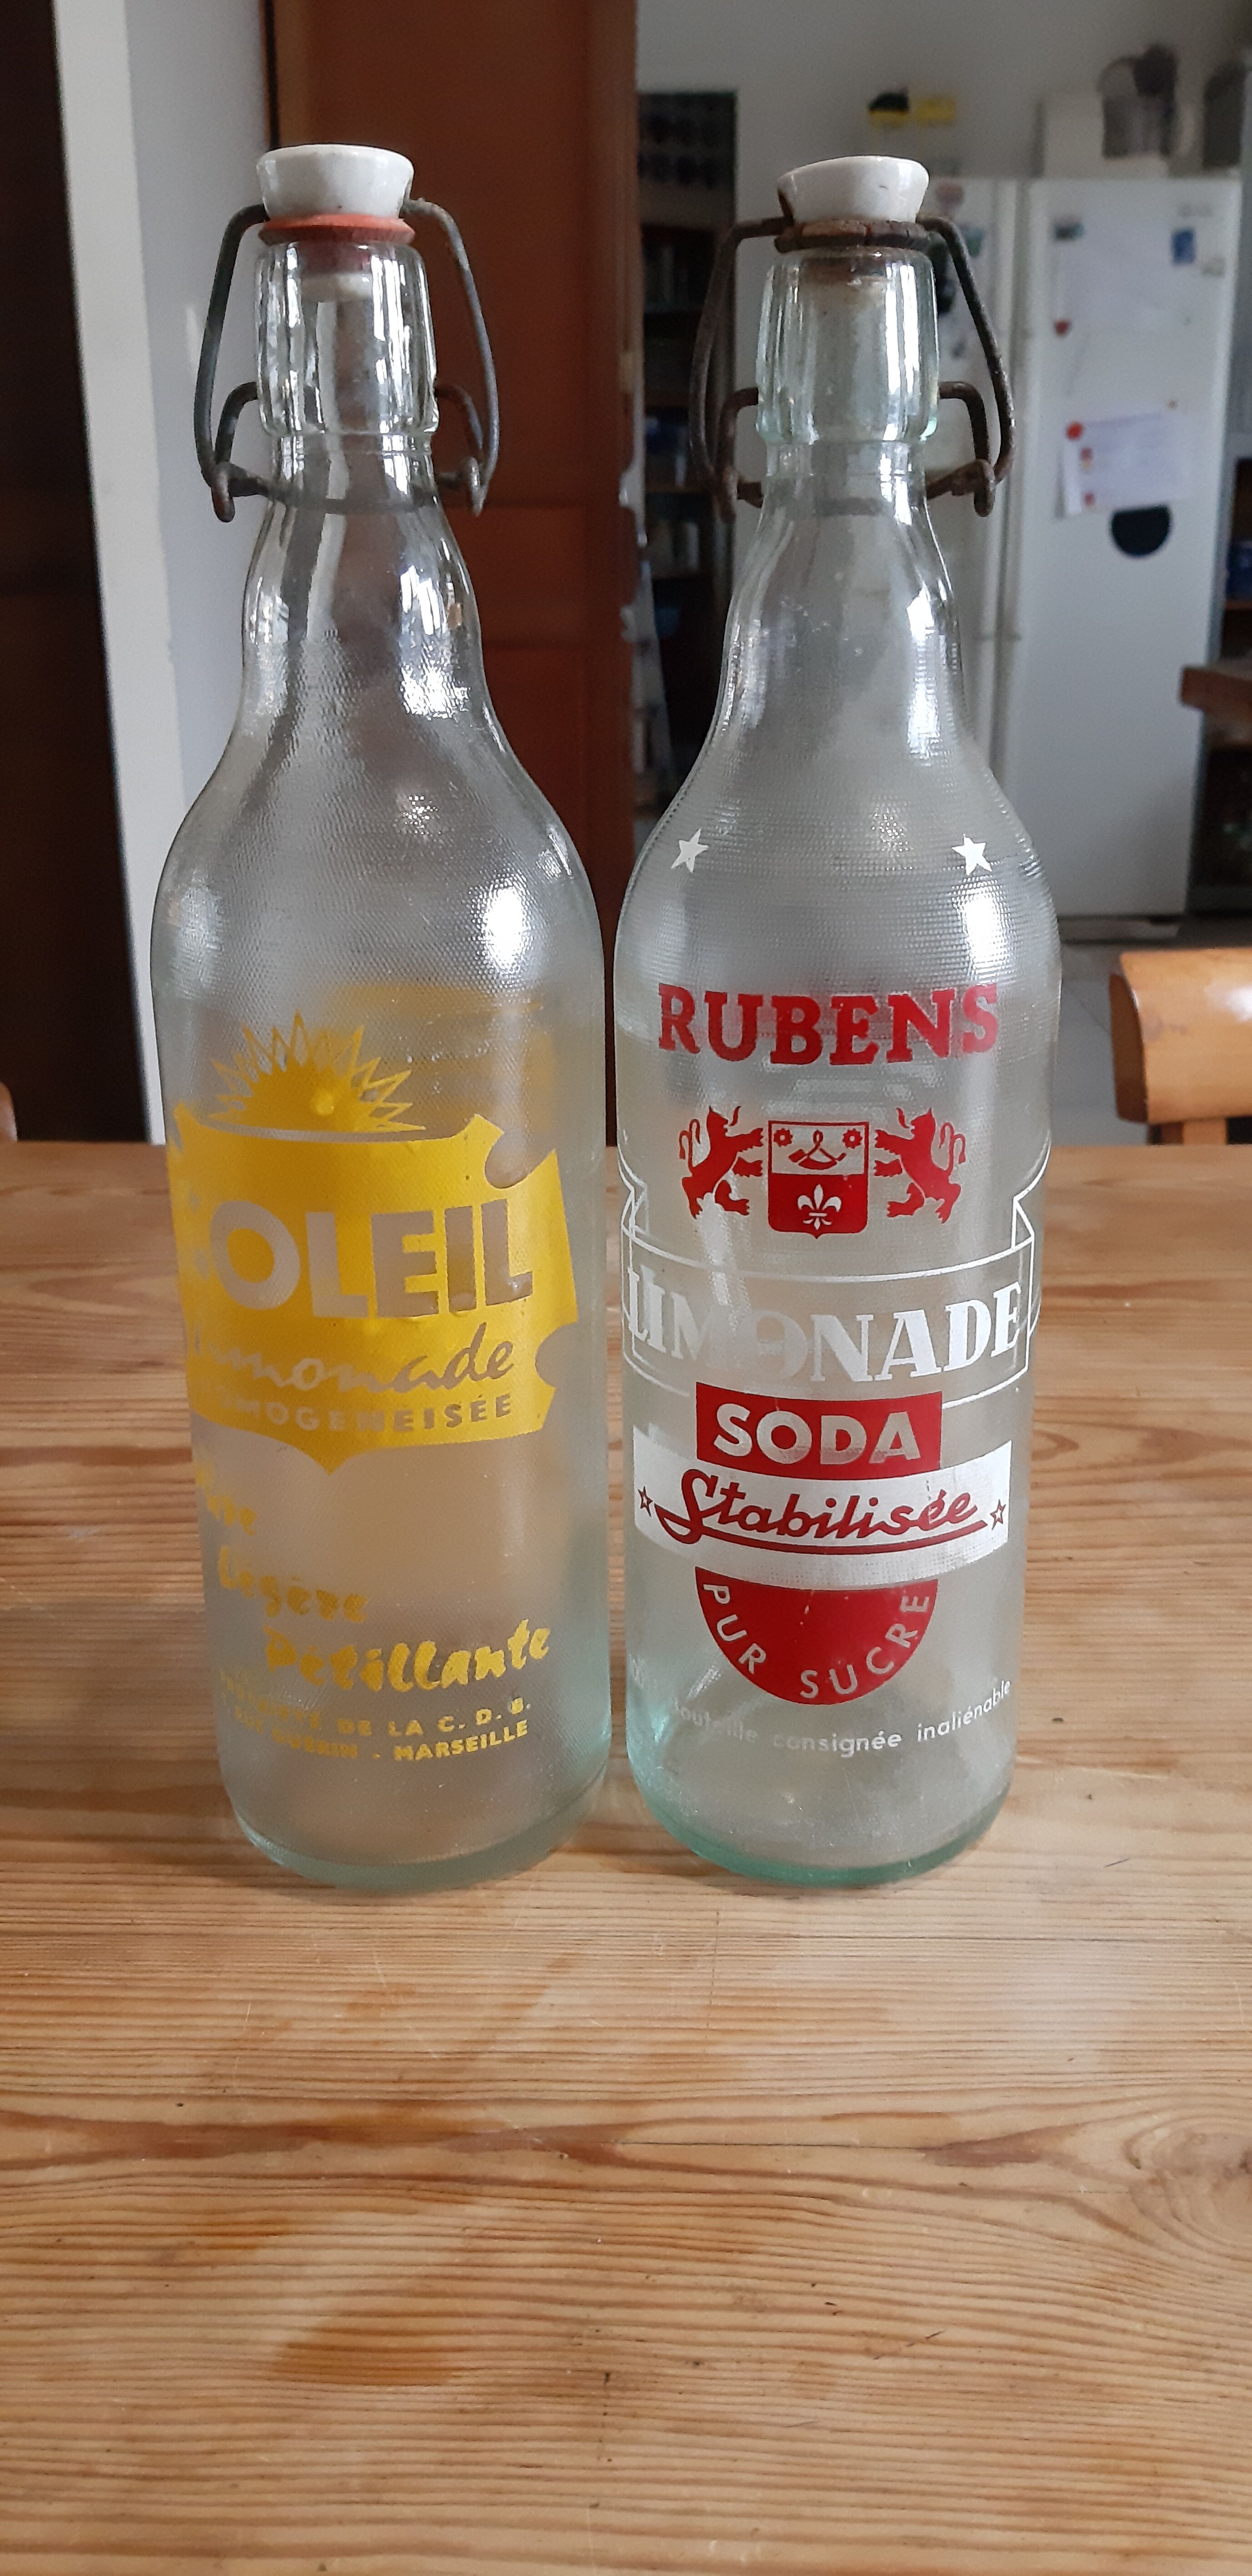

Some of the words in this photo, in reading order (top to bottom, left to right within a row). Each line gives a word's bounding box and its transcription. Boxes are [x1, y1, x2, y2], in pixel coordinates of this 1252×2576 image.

[658, 983, 999, 1065] RUBENS
[189, 1190, 533, 1319] OLEIL
[193, 1322, 515, 1394] imonade
[627, 1267, 1022, 1382] LIMONADE
[713, 1403, 921, 1465] SODA
[654, 1469, 988, 1555] Stabilisée
[263, 1619, 550, 1692] Pétillante
[703, 1584, 767, 1675] PUR
[800, 1595, 930, 1699] SUCRE
[388, 1720, 424, 1737] LA
[393, 1719, 528, 1761] MARSEILLE
[671, 1695, 758, 1744] outille
[774, 1730, 903, 1758] consignée
[916, 1679, 1011, 1742] inaliénable
